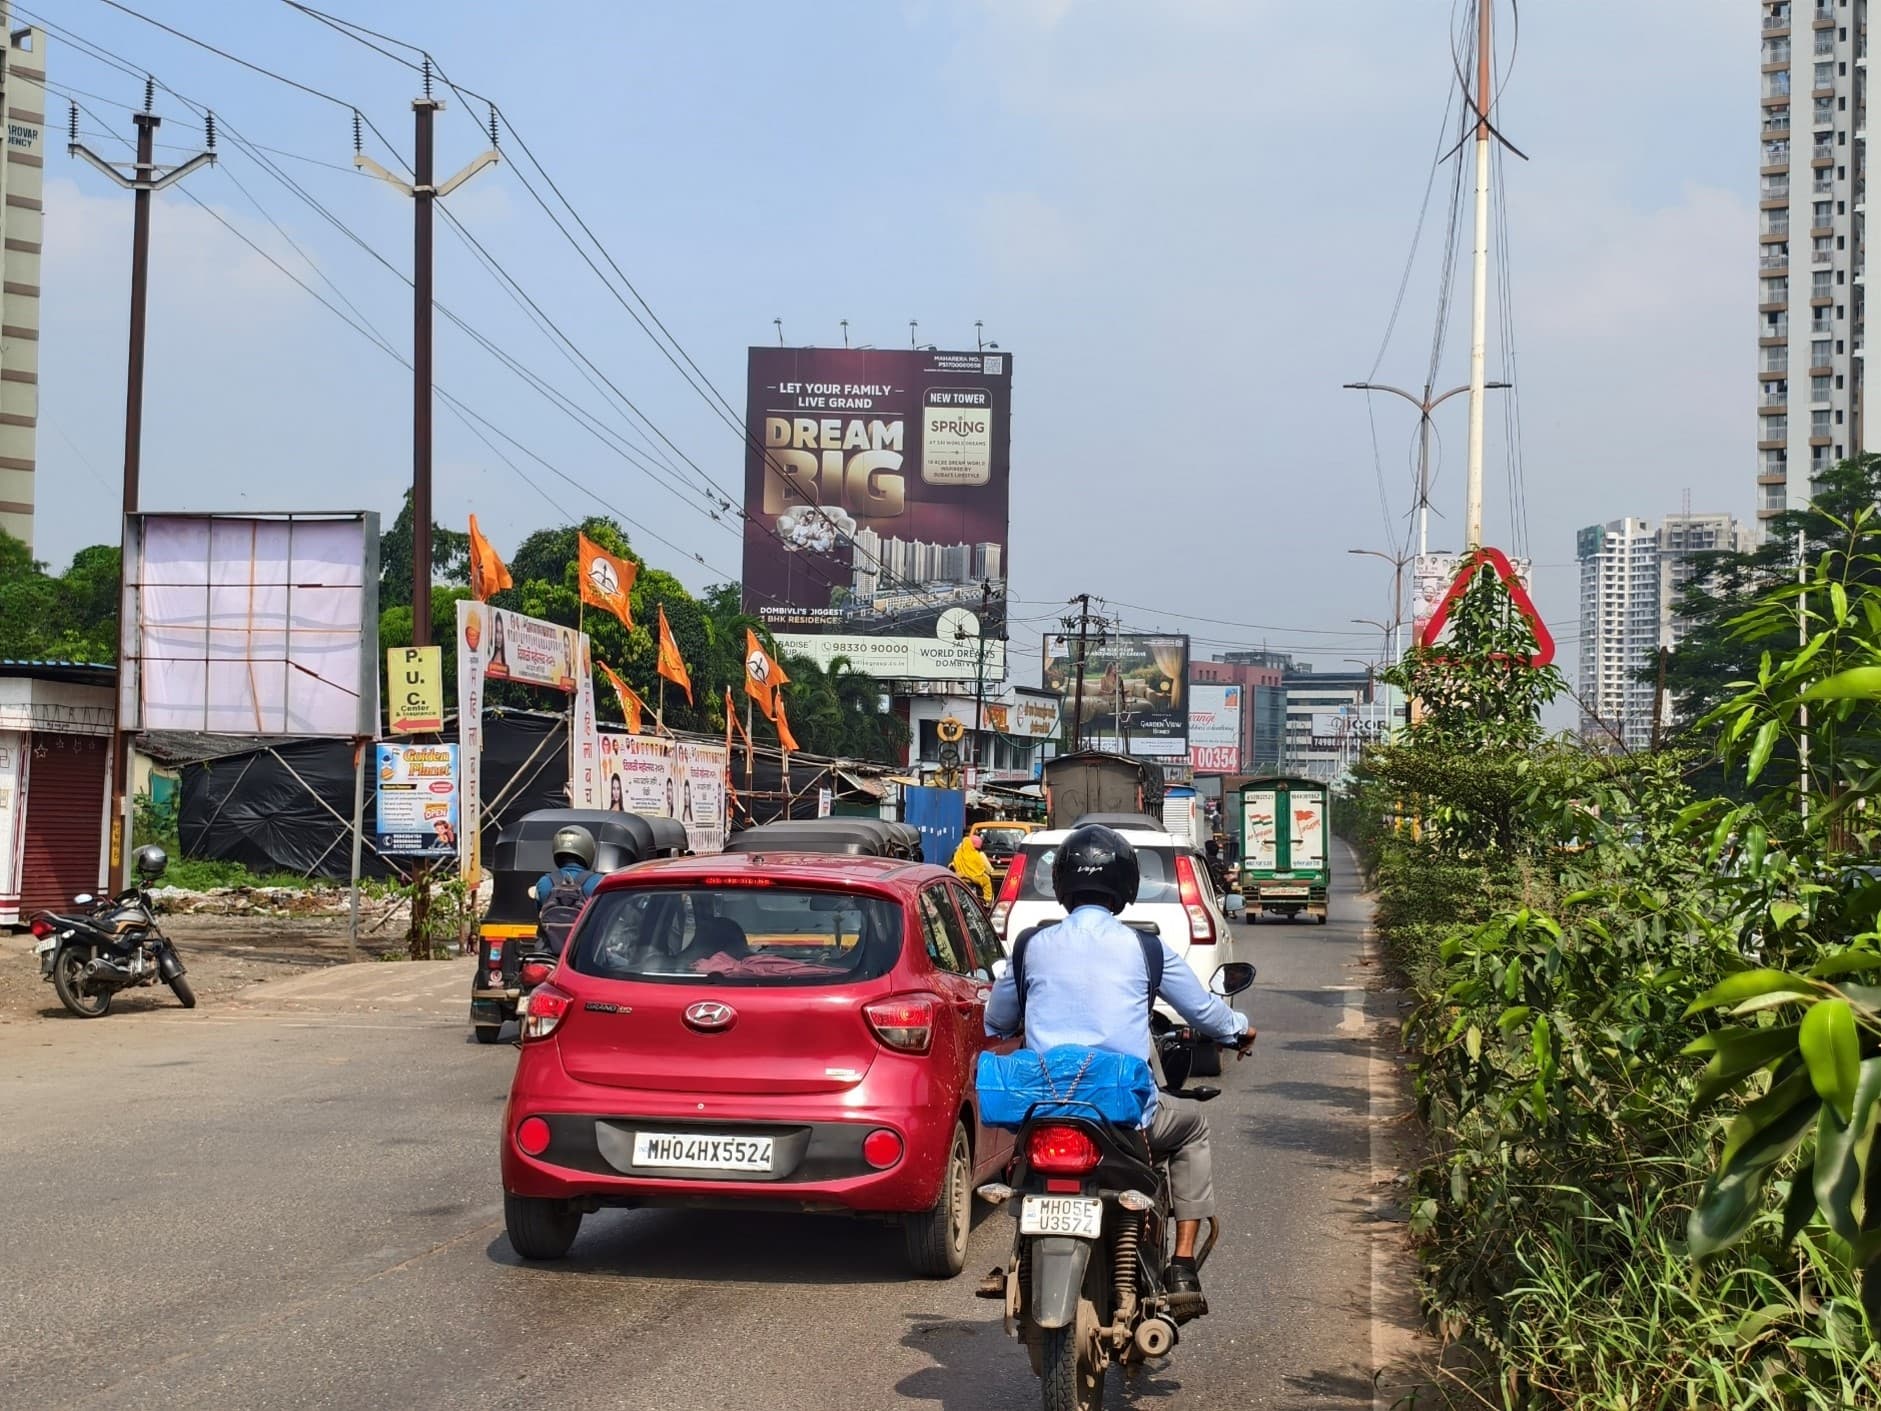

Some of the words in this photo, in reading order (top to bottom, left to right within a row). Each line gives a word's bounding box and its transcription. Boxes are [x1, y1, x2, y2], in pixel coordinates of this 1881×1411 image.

[780, 382, 802, 394] LET
[805, 383, 841, 395] YOUR
[844, 385, 891, 396] FAMILY
[798, 397, 825, 407] LIVE
[829, 398, 872, 409] GRAND
[930, 393, 951, 403] NEW
[953, 394, 985, 404] TOWER
[765, 417, 904, 451] DREAM
[931, 420, 985, 437] SPRING
[763, 449, 905, 518] BIG
[760, 607, 807, 615] DOMBIVLI'S
[767, 615, 786, 623] BHK
[833, 643, 867, 653] 98330
[871, 644, 908, 653] 90000
[920, 649, 954, 658] WORLD
[406, 650, 422, 663] P.
[406, 671, 424, 684] U.
[407, 692, 426, 705] C.
[403, 748, 450, 762] Golden
[1198, 748, 1238, 769] 00354
[408, 763, 452, 777] Planet
[646, 1137, 772, 1166] MH04HX5524
[1040, 1200, 1094, 1218] MH05E
